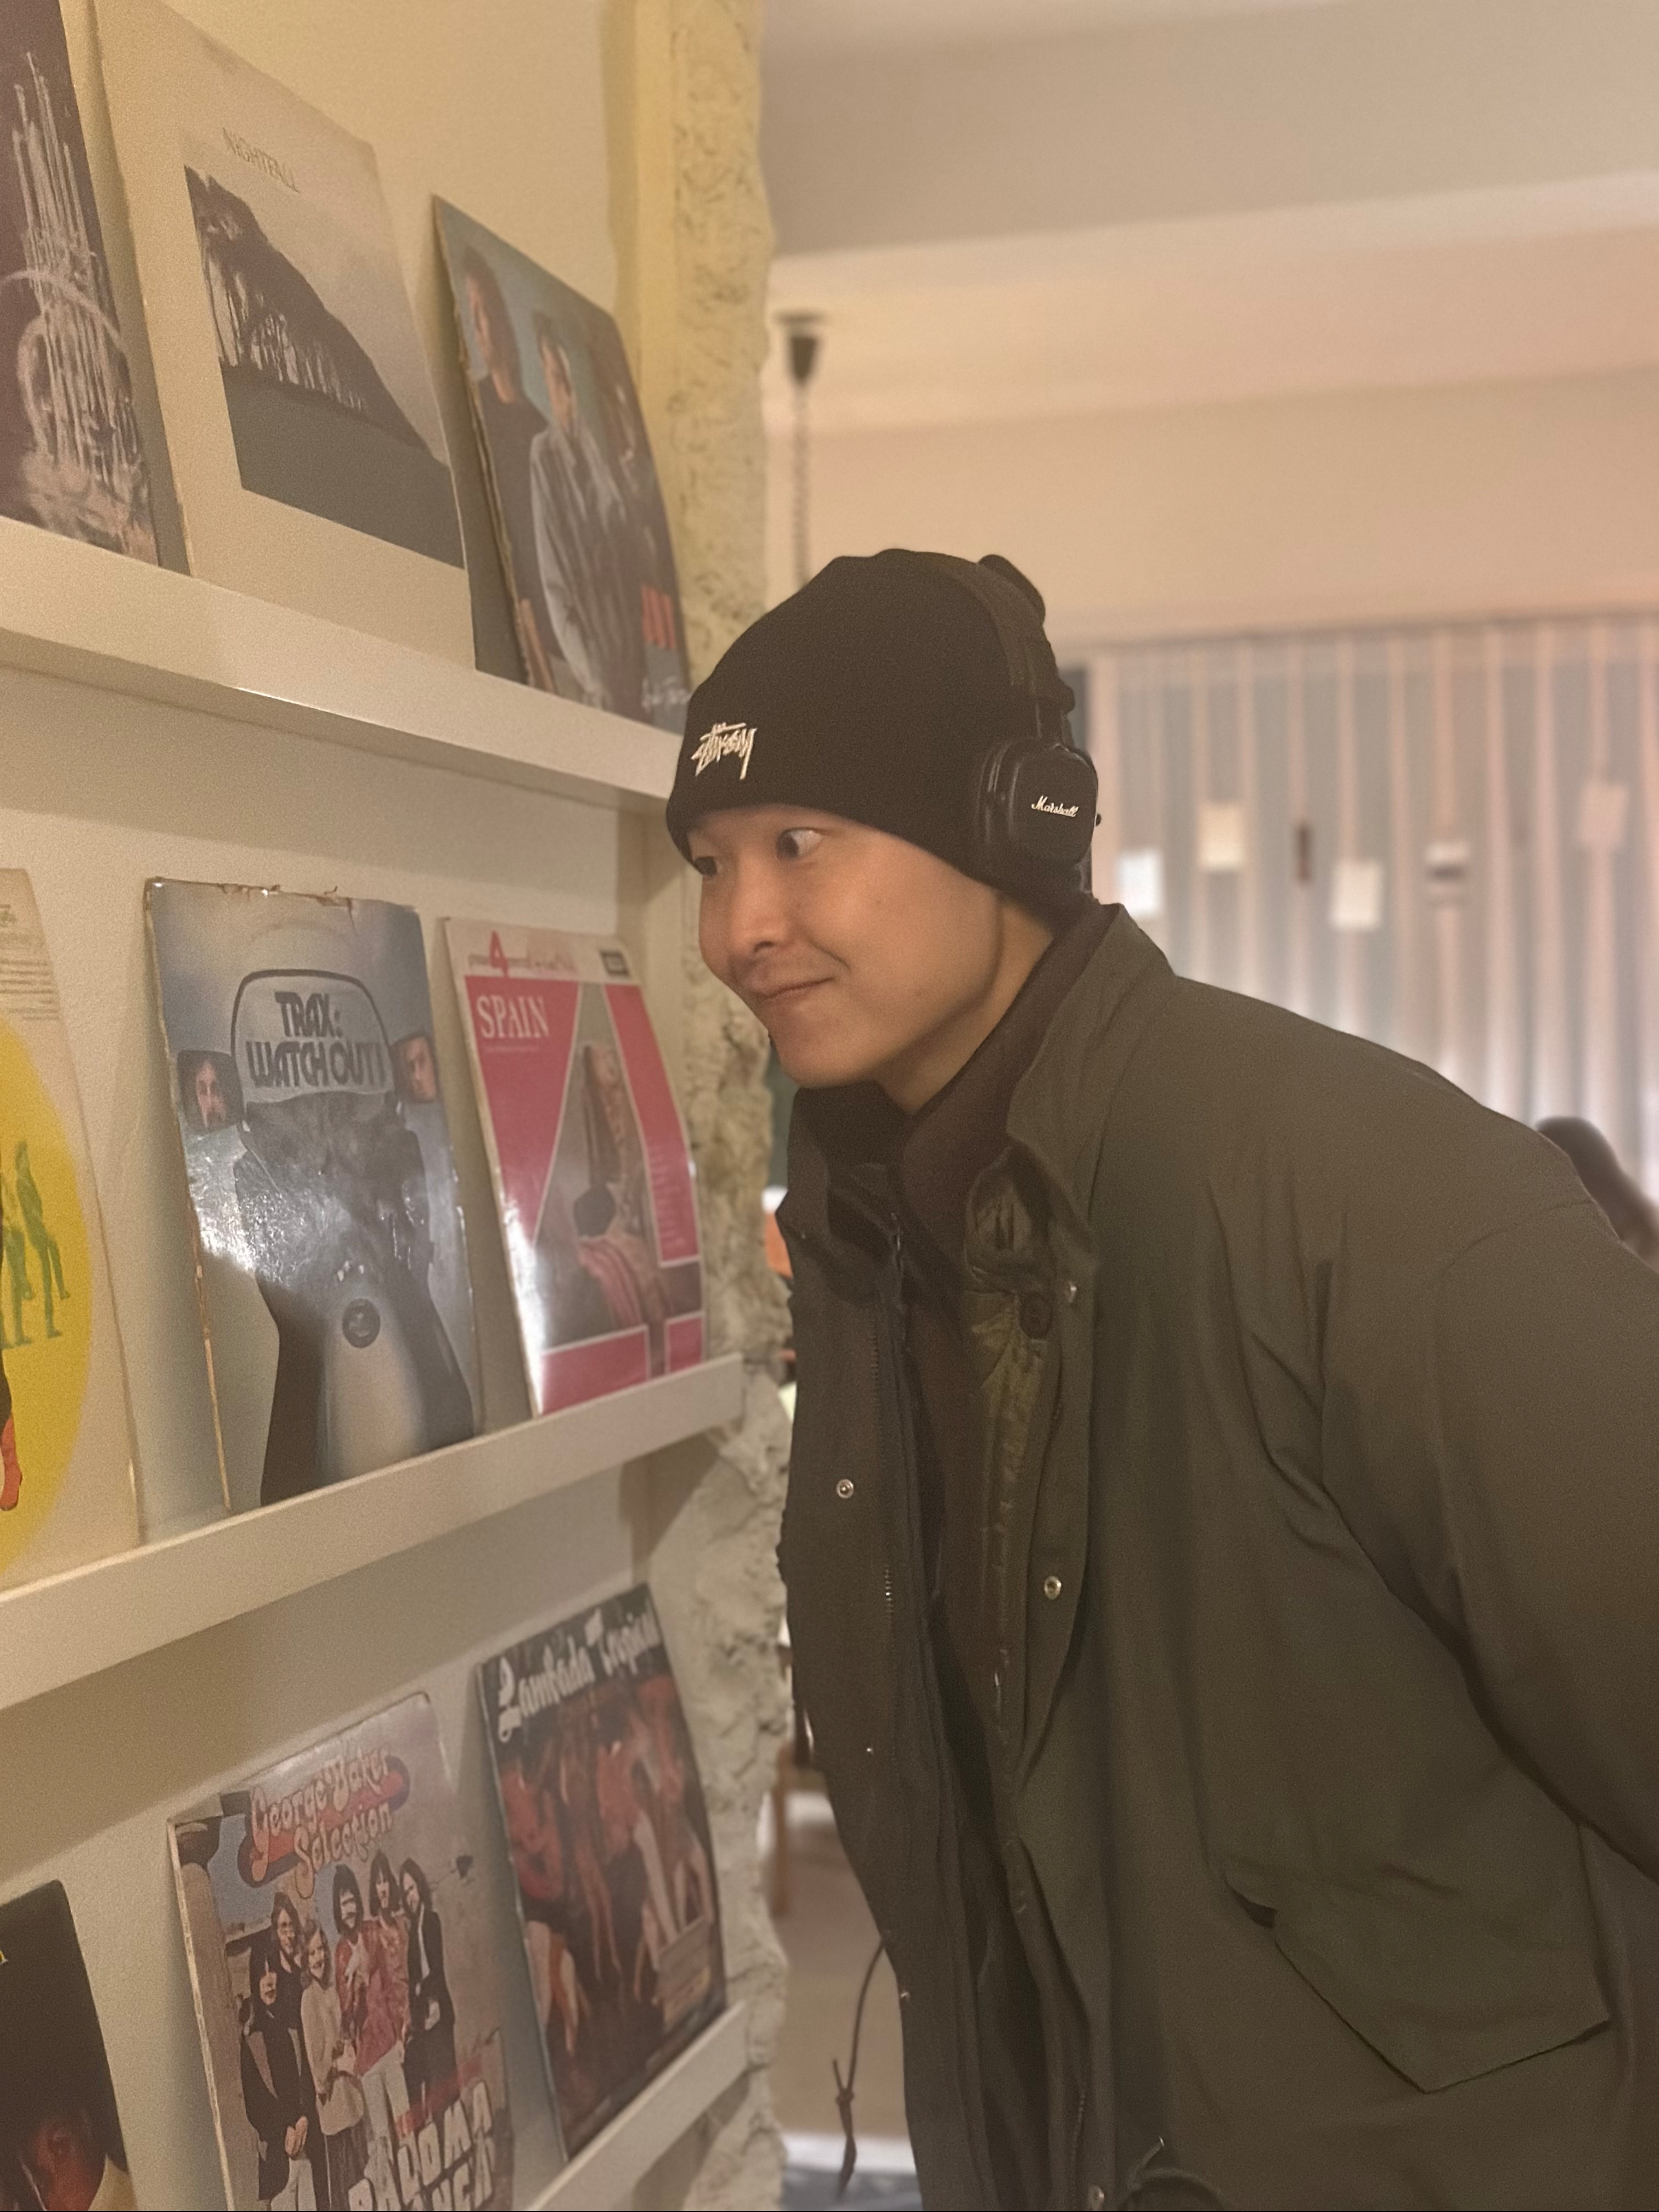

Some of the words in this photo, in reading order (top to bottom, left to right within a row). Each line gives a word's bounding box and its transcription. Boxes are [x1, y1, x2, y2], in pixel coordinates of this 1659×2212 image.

[1031, 794, 1079, 817] Marshall
[274, 991, 344, 1038] TRAX:
[477, 994, 550, 1040] SPAIN
[245, 1041, 329, 1090] WATCH
[251, 1780, 330, 1883] George
[294, 1801, 393, 1900] Selection
